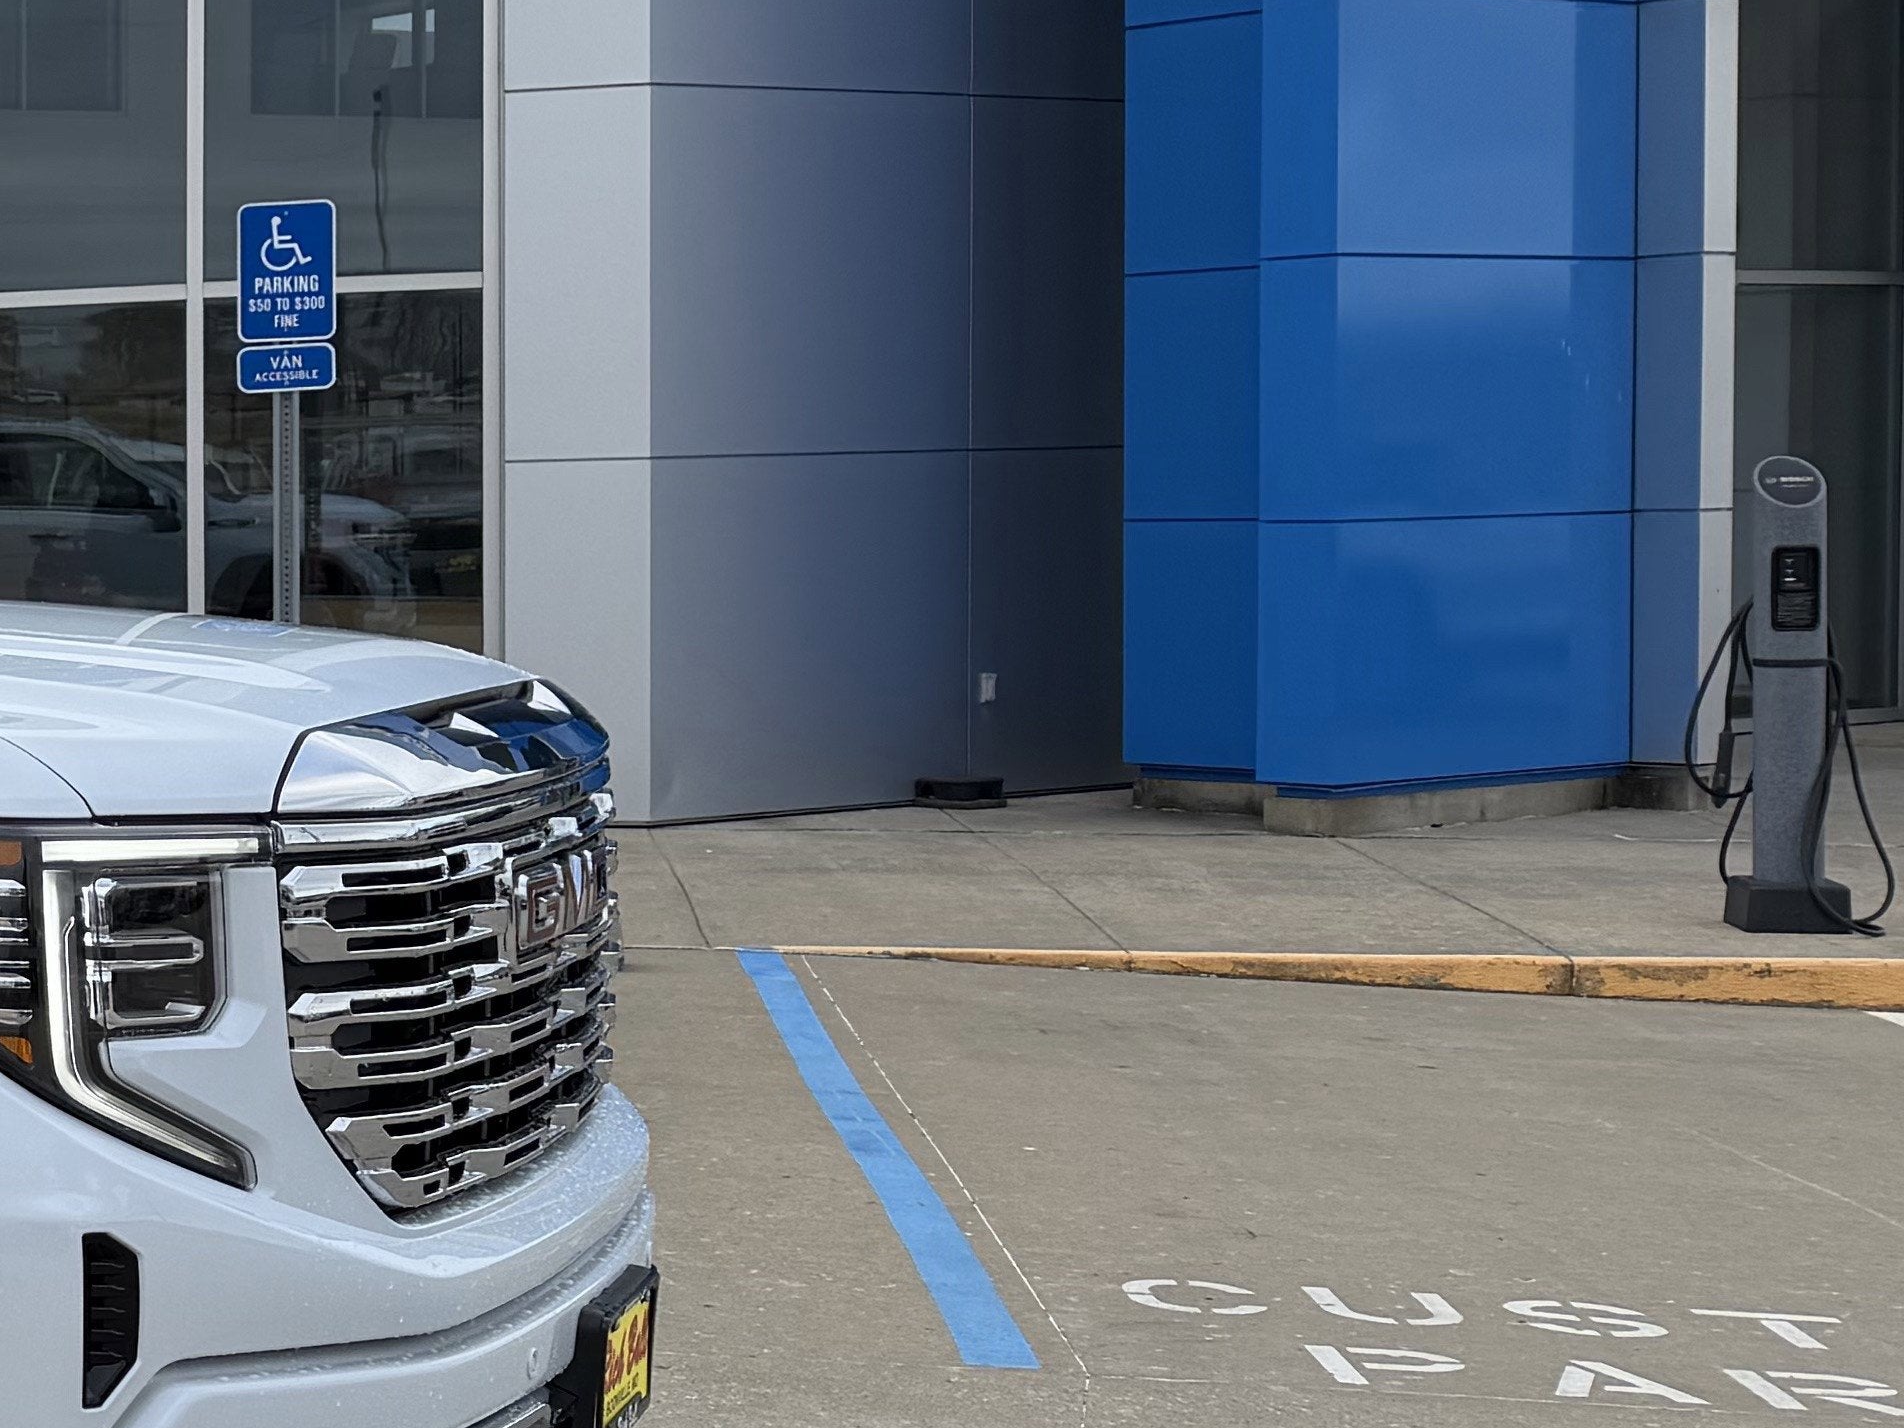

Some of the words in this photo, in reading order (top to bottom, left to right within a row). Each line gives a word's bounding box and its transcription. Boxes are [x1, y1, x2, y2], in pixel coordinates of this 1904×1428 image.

[254, 275, 319, 294] PARKING
[248, 299, 271, 312] $50
[276, 298, 289, 310] TO
[294, 296, 325, 310] $300
[274, 314, 299, 328] FINE
[270, 355, 302, 369] VAN
[254, 369, 319, 383] ACCESSIBLE
[1121, 1279, 1842, 1349] CUST
